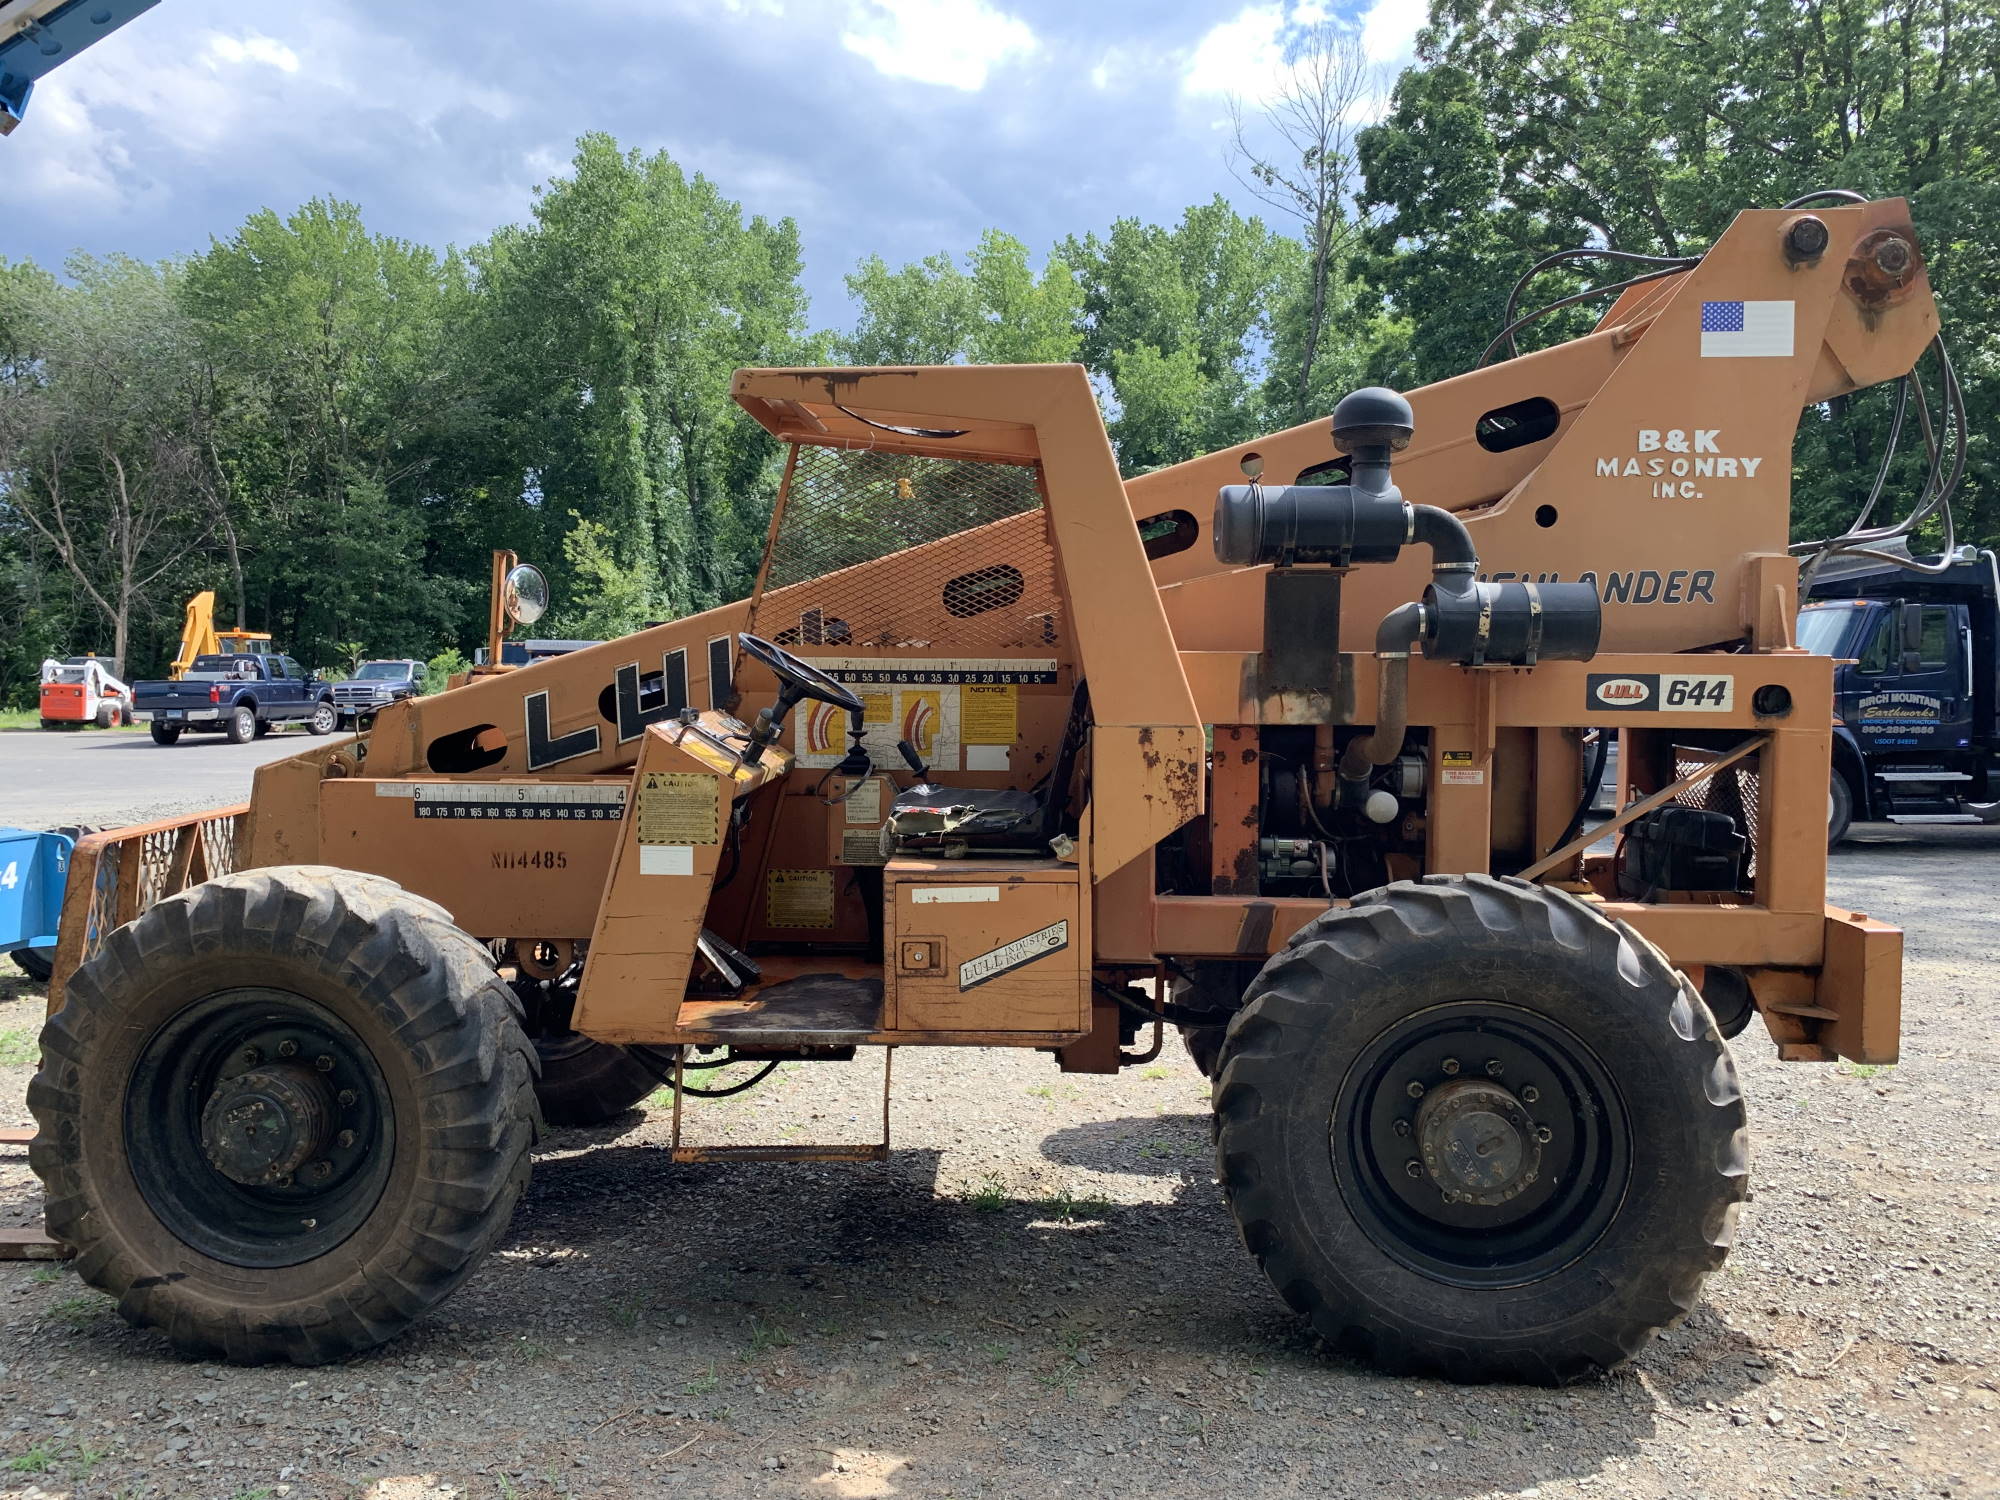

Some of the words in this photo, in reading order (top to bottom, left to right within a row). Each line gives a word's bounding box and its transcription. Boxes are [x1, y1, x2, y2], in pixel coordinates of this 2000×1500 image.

[1637, 429, 1721, 454] B&K
[1596, 457, 1762, 478] MASONRY
[1652, 481, 1703, 499] INC.
[1050, 661, 1056, 670] 0
[844, 673, 856, 682] 60
[862, 673, 873, 682] 55
[879, 673, 891, 682] 50
[896, 673, 907, 682] 45
[913, 674, 925, 682] 40
[931, 674, 942, 683] 35
[948, 674, 959, 683] 30
[965, 674, 977, 683] 25
[982, 674, 994, 683] 20
[1001, 674, 1011, 683] 15
[1019, 674, 1028, 683] 10
[1602, 684, 1643, 699] LULL
[1666, 680, 1727, 706] 644
[1859, 693, 1889, 709] BIRCH
[1891, 693, 1940, 710] MOUNTAIN
[1864, 706, 1935, 718] Earthworks
[414, 787, 421, 800] 6
[518, 788, 524, 801] 5
[617, 790, 624, 801] 4
[419, 807, 431, 816] 180
[436, 807, 448, 817] 175
[454, 807, 465, 817] 170
[470, 808, 482, 817] 165
[487, 808, 499, 817] 160
[504, 808, 517, 817] 155
[522, 808, 534, 818] 150
[539, 809, 551, 818] 145
[556, 809, 568, 818] 140
[574, 809, 586, 818] 135
[591, 809, 603, 818] 130
[608, 809, 620, 819] 125
[0, 861, 18, 890] 4
[1004, 924, 1064, 957] INDUSTRIES
[964, 954, 1003, 980] LULL
